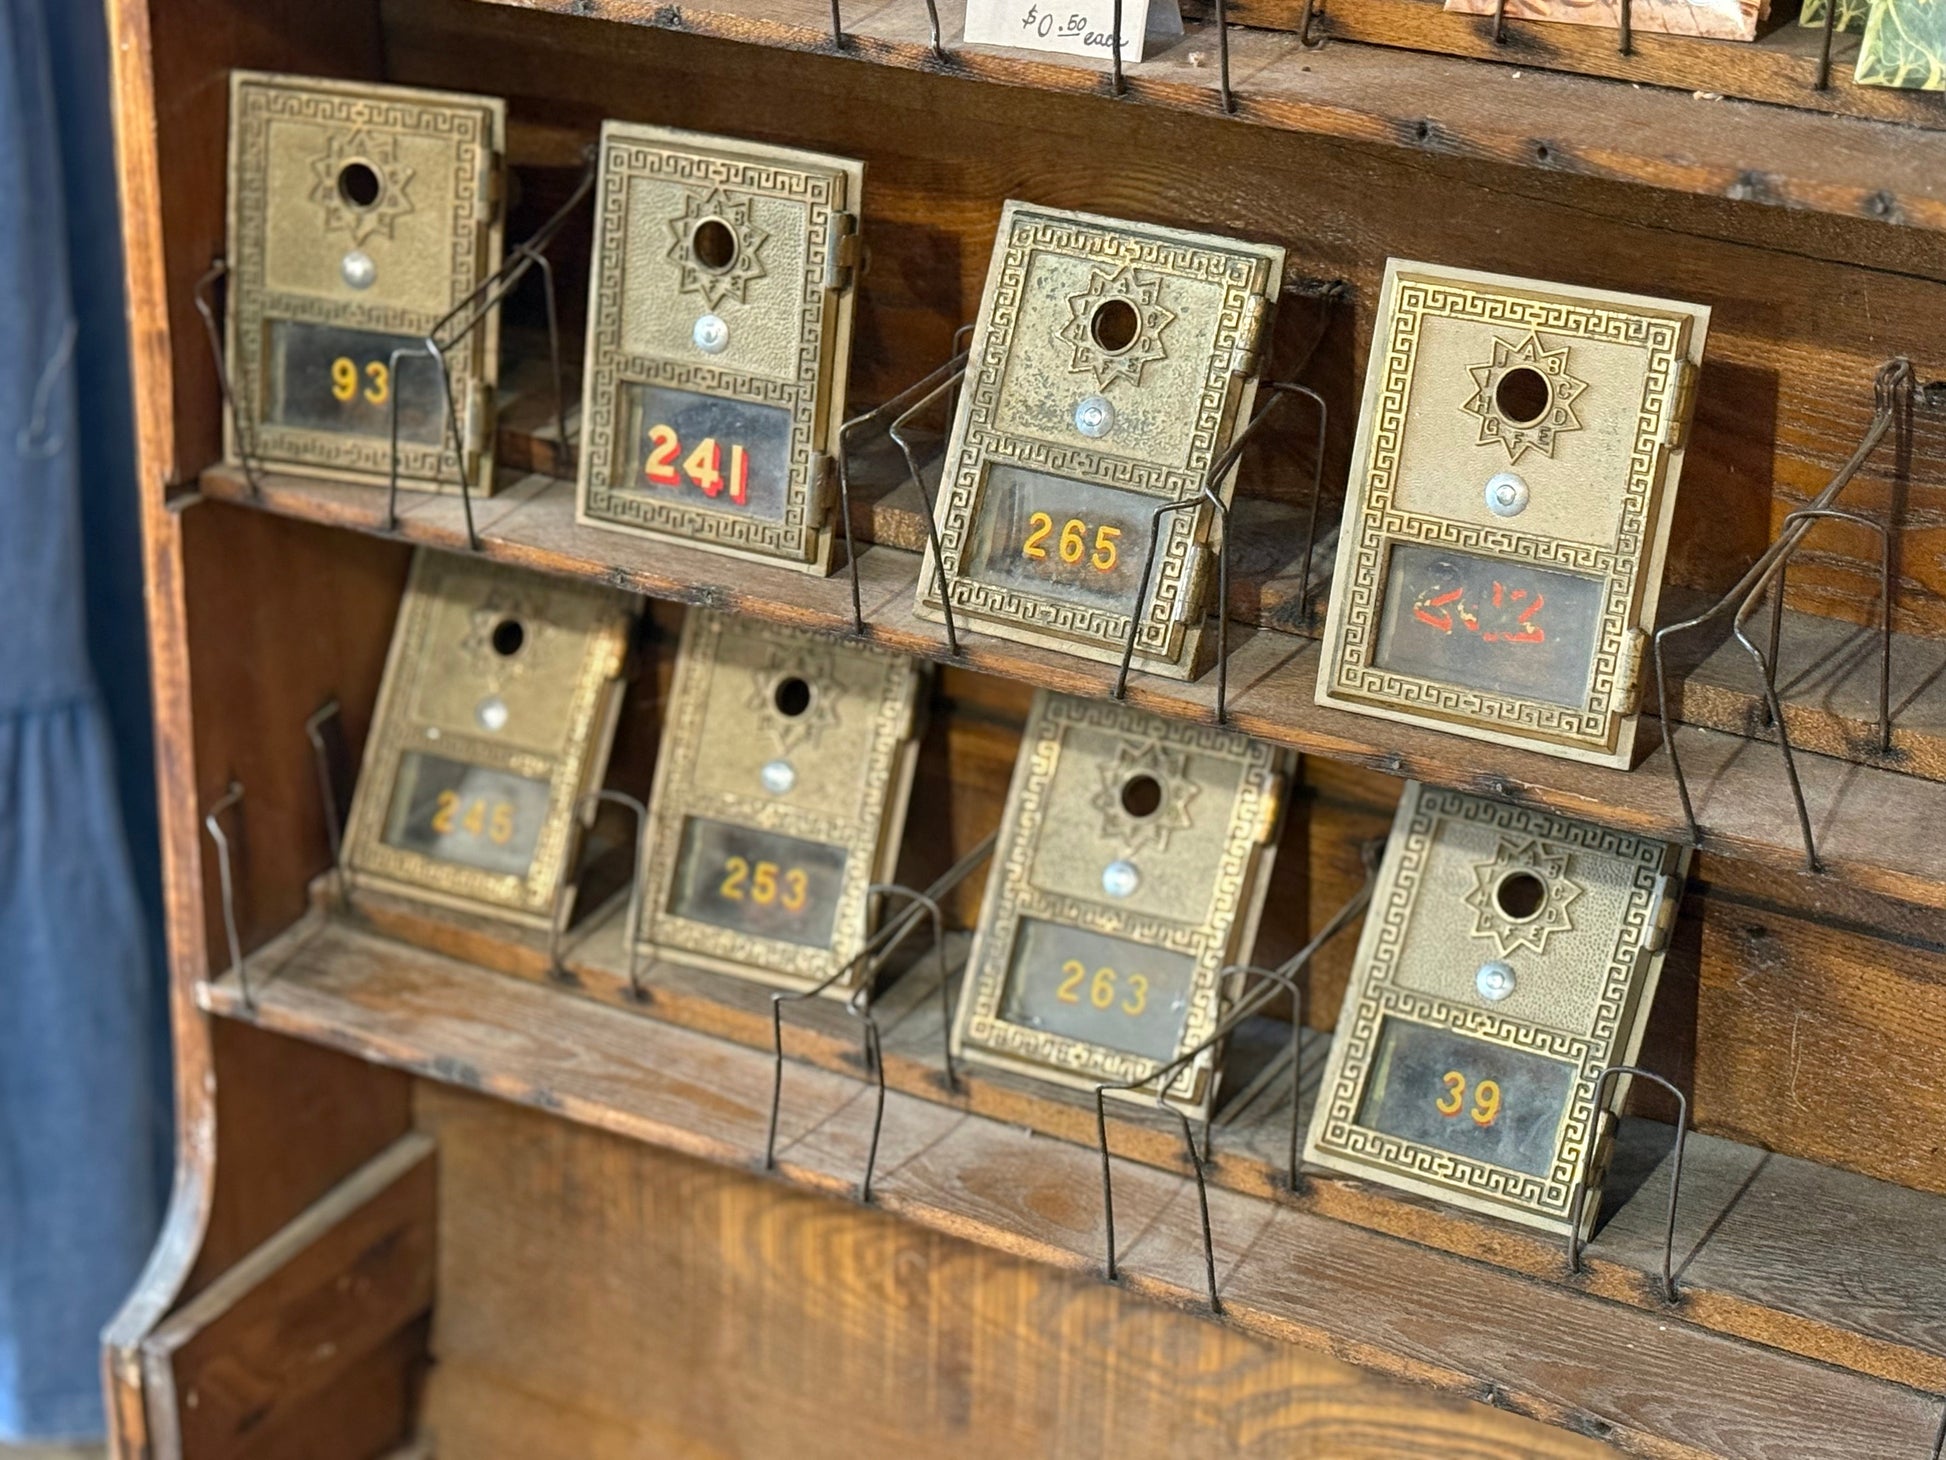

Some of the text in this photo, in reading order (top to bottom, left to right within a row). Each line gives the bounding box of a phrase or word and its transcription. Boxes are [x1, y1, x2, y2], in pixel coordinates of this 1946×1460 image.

[331, 356, 389, 405] 93
[1475, 343, 1572, 450] A B C D E F G H I J
[645, 424, 748, 506] 241
[1023, 512, 1122, 573] 265
[431, 788, 515, 845] 245
[720, 856, 809, 914] 253
[1552, 885, 1565, 900] C
[1546, 907, 1558, 924] D
[1056, 959, 1148, 1017] 263
[1436, 1071, 1501, 1127] 39
